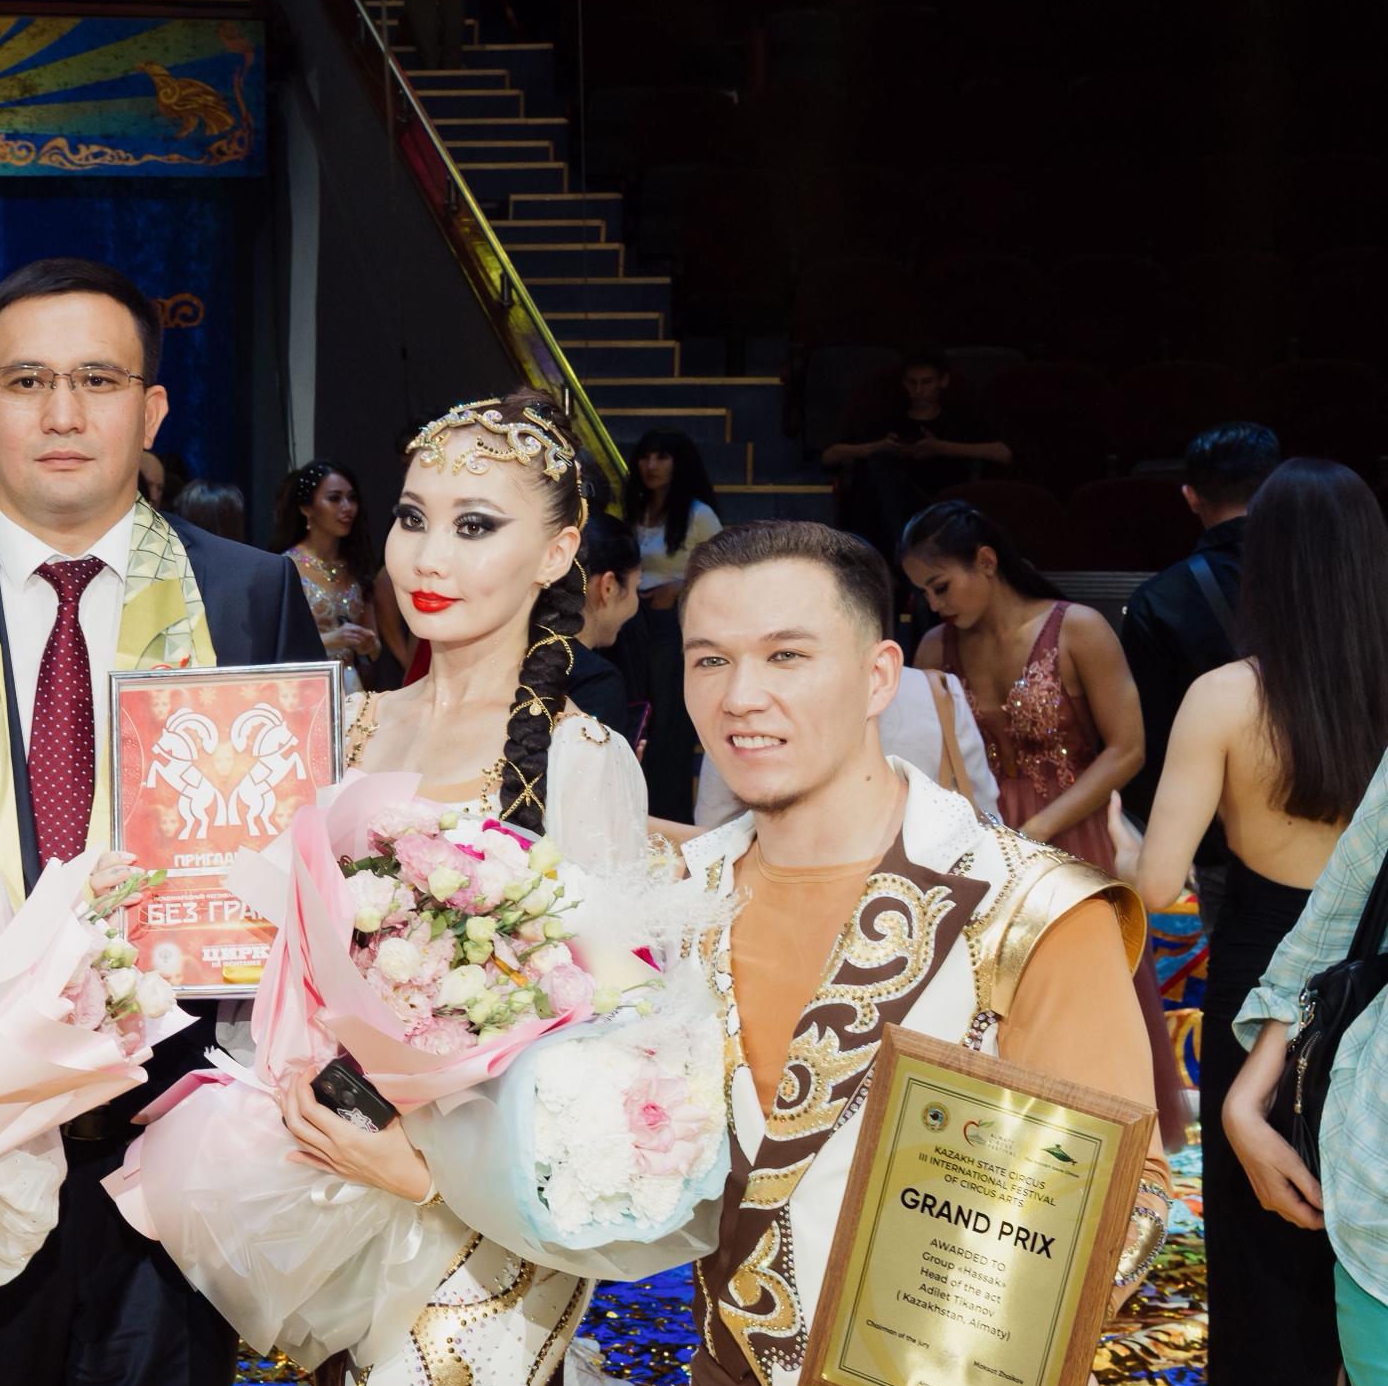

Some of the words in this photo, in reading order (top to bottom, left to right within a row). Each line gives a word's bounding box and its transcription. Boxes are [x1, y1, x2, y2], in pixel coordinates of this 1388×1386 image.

[174, 852, 237, 867] ПРИГЛА
[147, 902, 198, 924] БЕЗ
[930, 1156, 1007, 1190] INTERNATIONAL
[1012, 1184, 1056, 1206] FESTIVAL
[934, 1146, 975, 1164] KAZAKH
[977, 1158, 1007, 1176] STATE
[1009, 1171, 1046, 1189] CIRCUS
[944, 1174, 957, 1184] OF
[961, 1180, 996, 1197] CIRCUS
[999, 1193, 1024, 1207] ARTS
[900, 1187, 991, 1234] GRAND
[998, 1221, 1056, 1259] PRIX
[922, 1251, 955, 1270] Group
[930, 1238, 988, 1265] AWARDED
[992, 1259, 1006, 1271] TO
[918, 1283, 950, 1301] Adilet
[954, 1295, 994, 1317] Tikanov
[920, 1266, 948, 1284] Head
[950, 1279, 962, 1288] of
[964, 1283, 981, 1295] the
[984, 1292, 1001, 1304] act
[969, 1318, 1011, 1341] Almaty)
